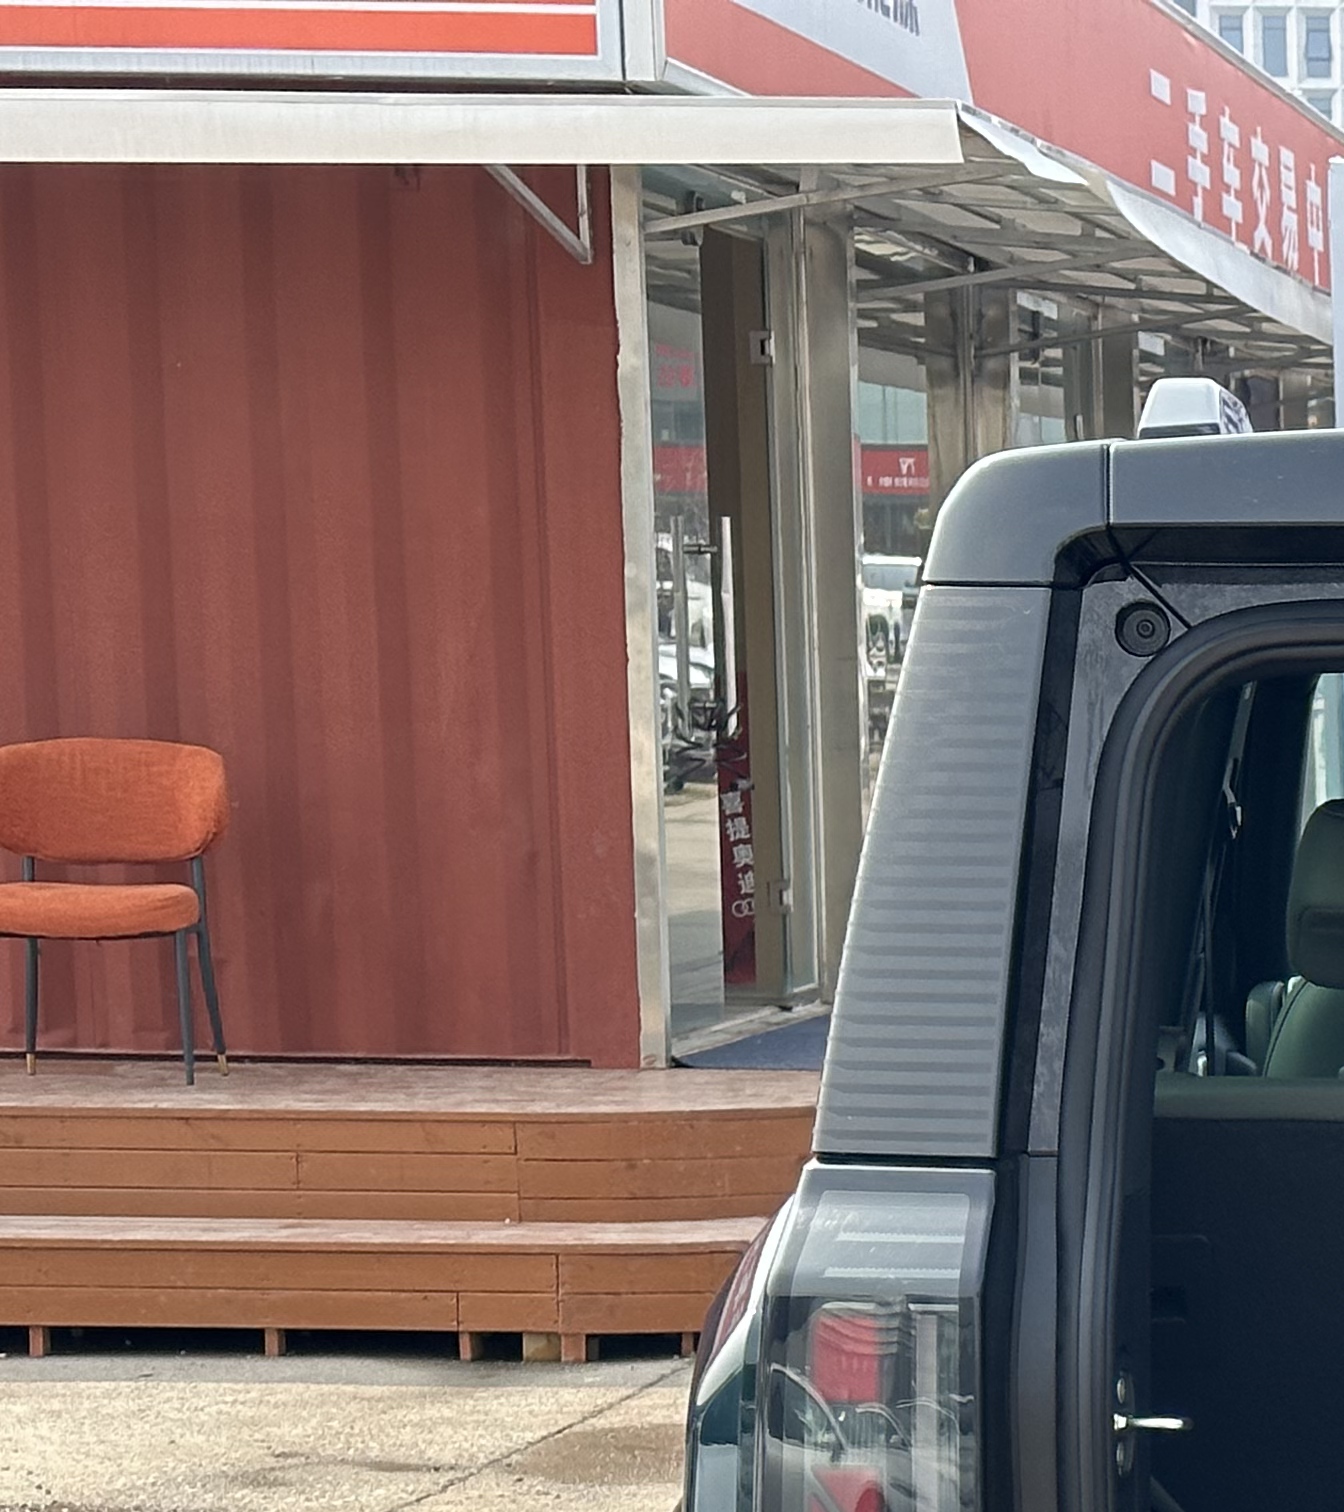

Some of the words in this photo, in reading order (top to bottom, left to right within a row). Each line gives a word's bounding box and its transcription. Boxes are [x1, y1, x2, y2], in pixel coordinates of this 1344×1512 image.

[1150, 67, 1325, 288] 二手车交易中
